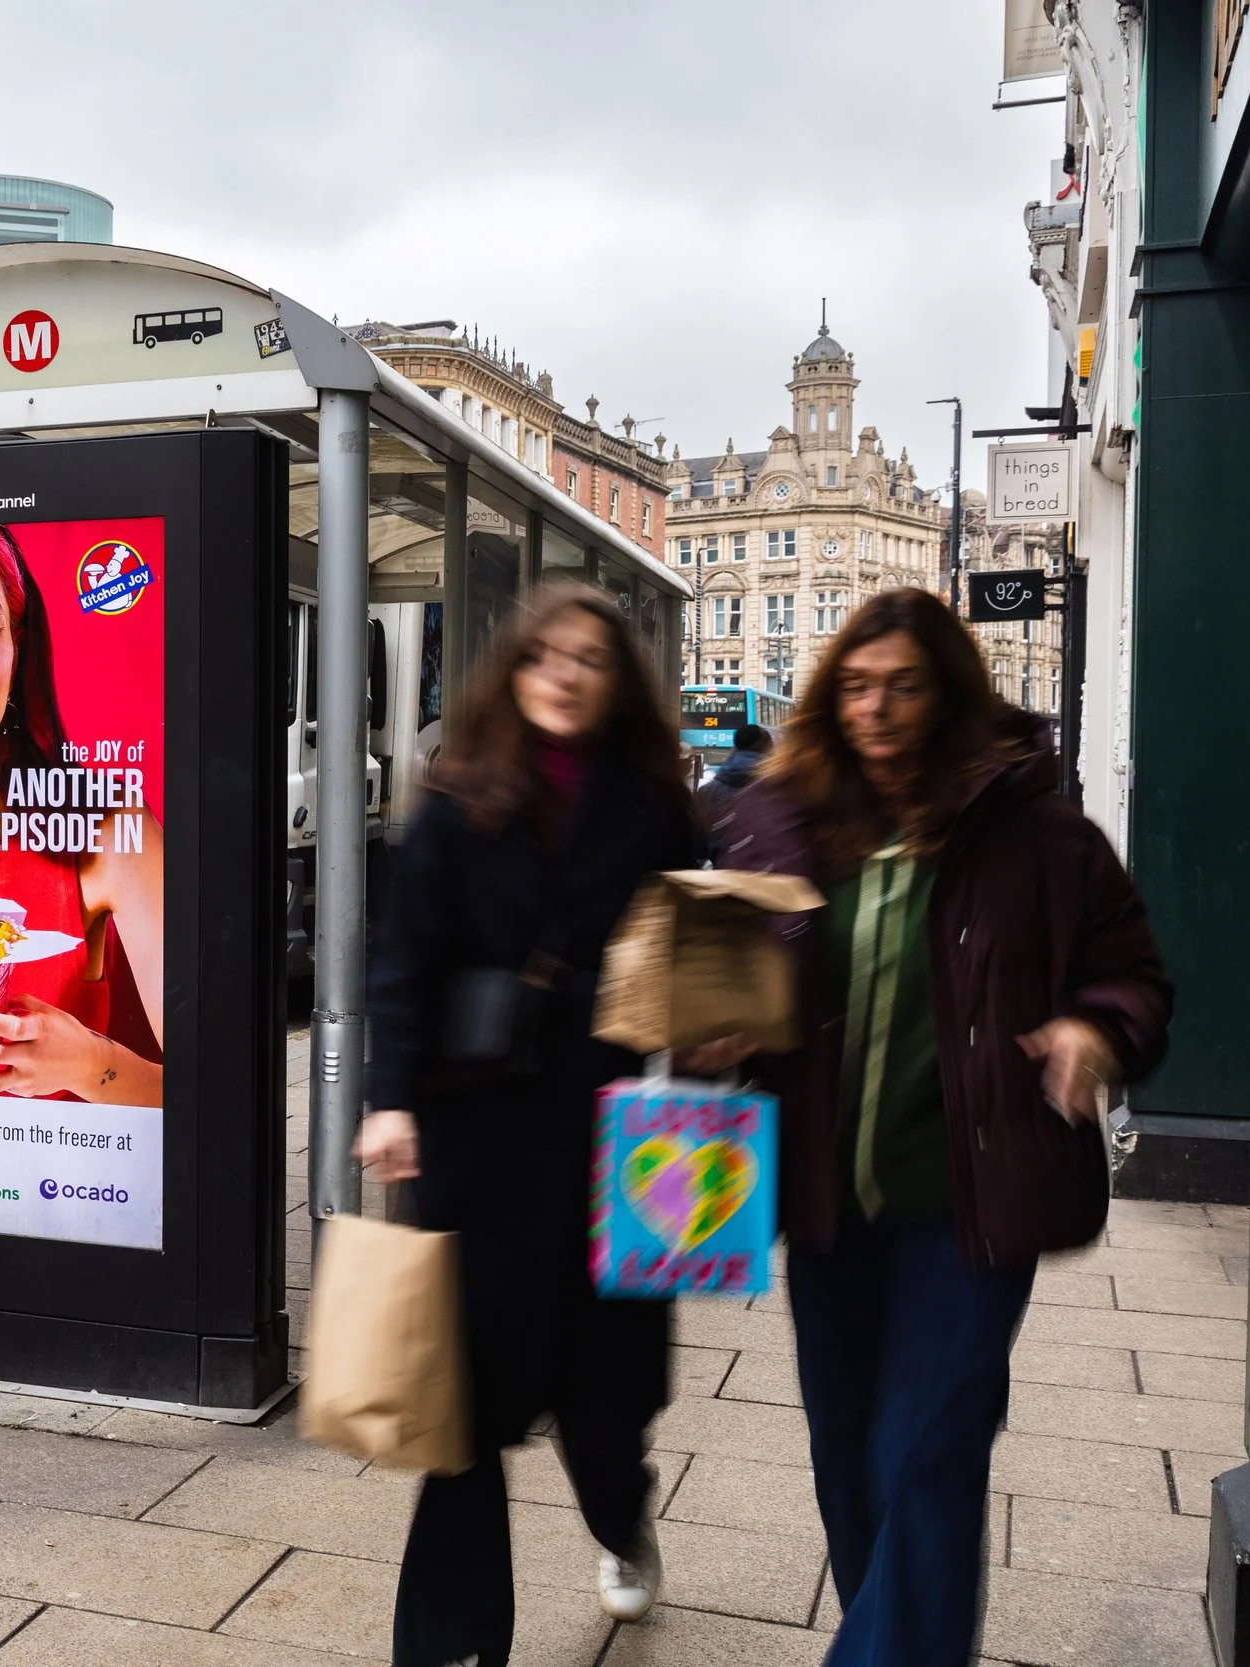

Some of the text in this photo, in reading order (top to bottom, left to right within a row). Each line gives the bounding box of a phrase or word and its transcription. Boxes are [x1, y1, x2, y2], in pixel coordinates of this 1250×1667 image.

[10, 320, 52, 362] M
[1005, 458, 1060, 478] things
[1024, 479, 1039, 493] in
[1003, 492, 1059, 512] bread
[80, 569, 150, 610] Kitchen Joy
[61, 740, 144, 763] the JOY of
[6, 768, 144, 808] ANOTHER
[114, 814, 143, 854] IN
[30, 1124, 53, 1145] the
[58, 1126, 112, 1149] freezer
[116, 1133, 132, 1151] at
[62, 1184, 129, 1204] ocado
